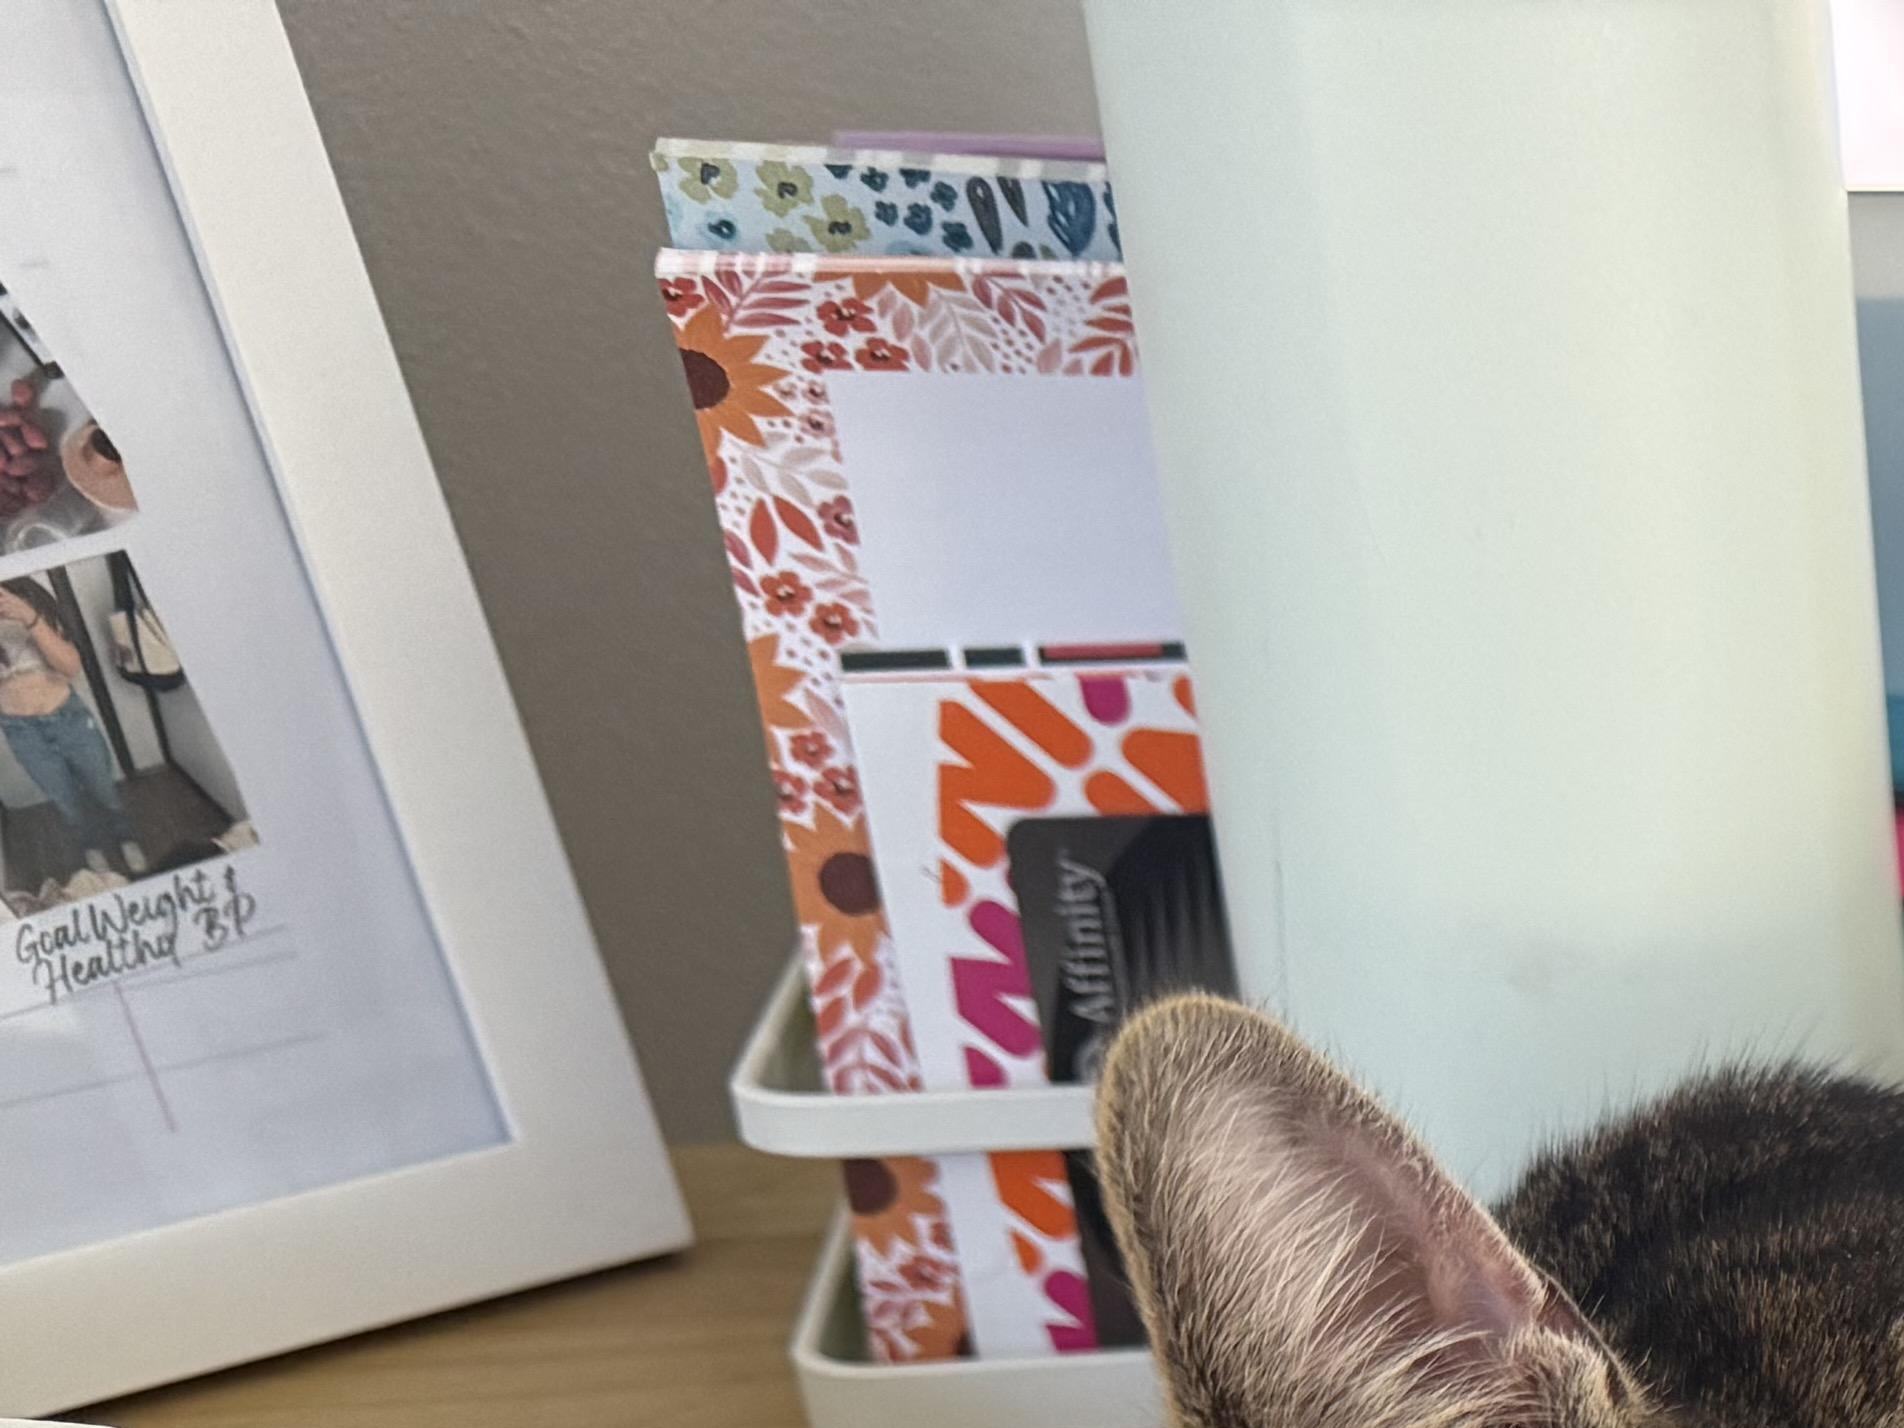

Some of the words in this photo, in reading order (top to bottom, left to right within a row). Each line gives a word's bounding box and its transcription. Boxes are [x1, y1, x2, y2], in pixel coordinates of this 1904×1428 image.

[16, 908, 90, 964] Goal
[89, 869, 216, 941] Weight
[1056, 854, 1113, 1022] Affinity
[33, 929, 182, 1006] Healthy
